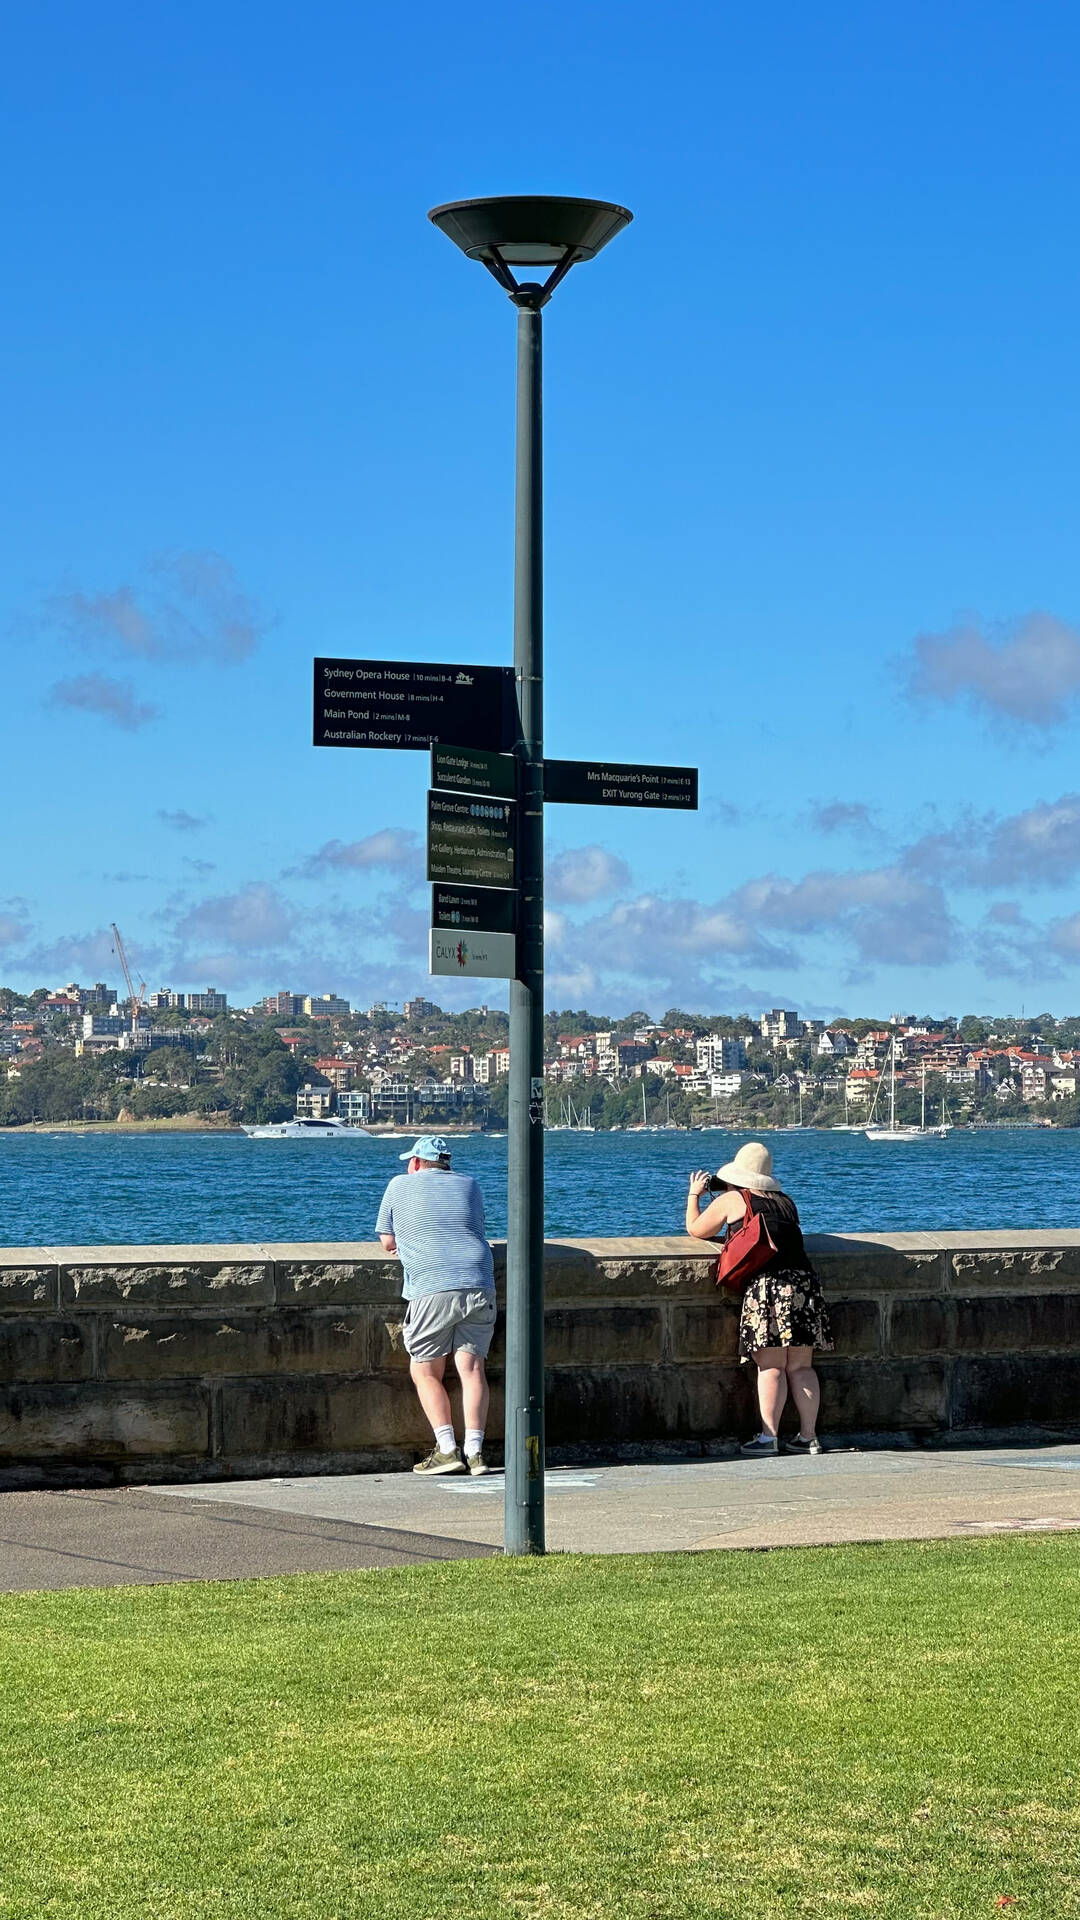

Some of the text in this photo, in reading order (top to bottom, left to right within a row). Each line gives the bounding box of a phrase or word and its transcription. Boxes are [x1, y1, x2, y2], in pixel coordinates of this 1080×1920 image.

[324, 668, 354, 679] Sydney
[356, 670, 381, 680] Opera
[384, 671, 410, 680] House
[324, 688, 376, 699] Government
[379, 691, 404, 700] House
[324, 709, 345, 718] Main
[348, 710, 369, 719] Pond
[324, 730, 366, 740] Australian
[369, 731, 401, 742] Rockery
[588, 772, 600, 780] Mrs
[602, 772, 640, 784] Macquarie's
[642, 774, 659, 783] Point
[603, 789, 617, 797] EXIT
[619, 790, 642, 800] Yurong
[644, 791, 660, 800] Gate
[436, 946, 456, 959] CALYX
